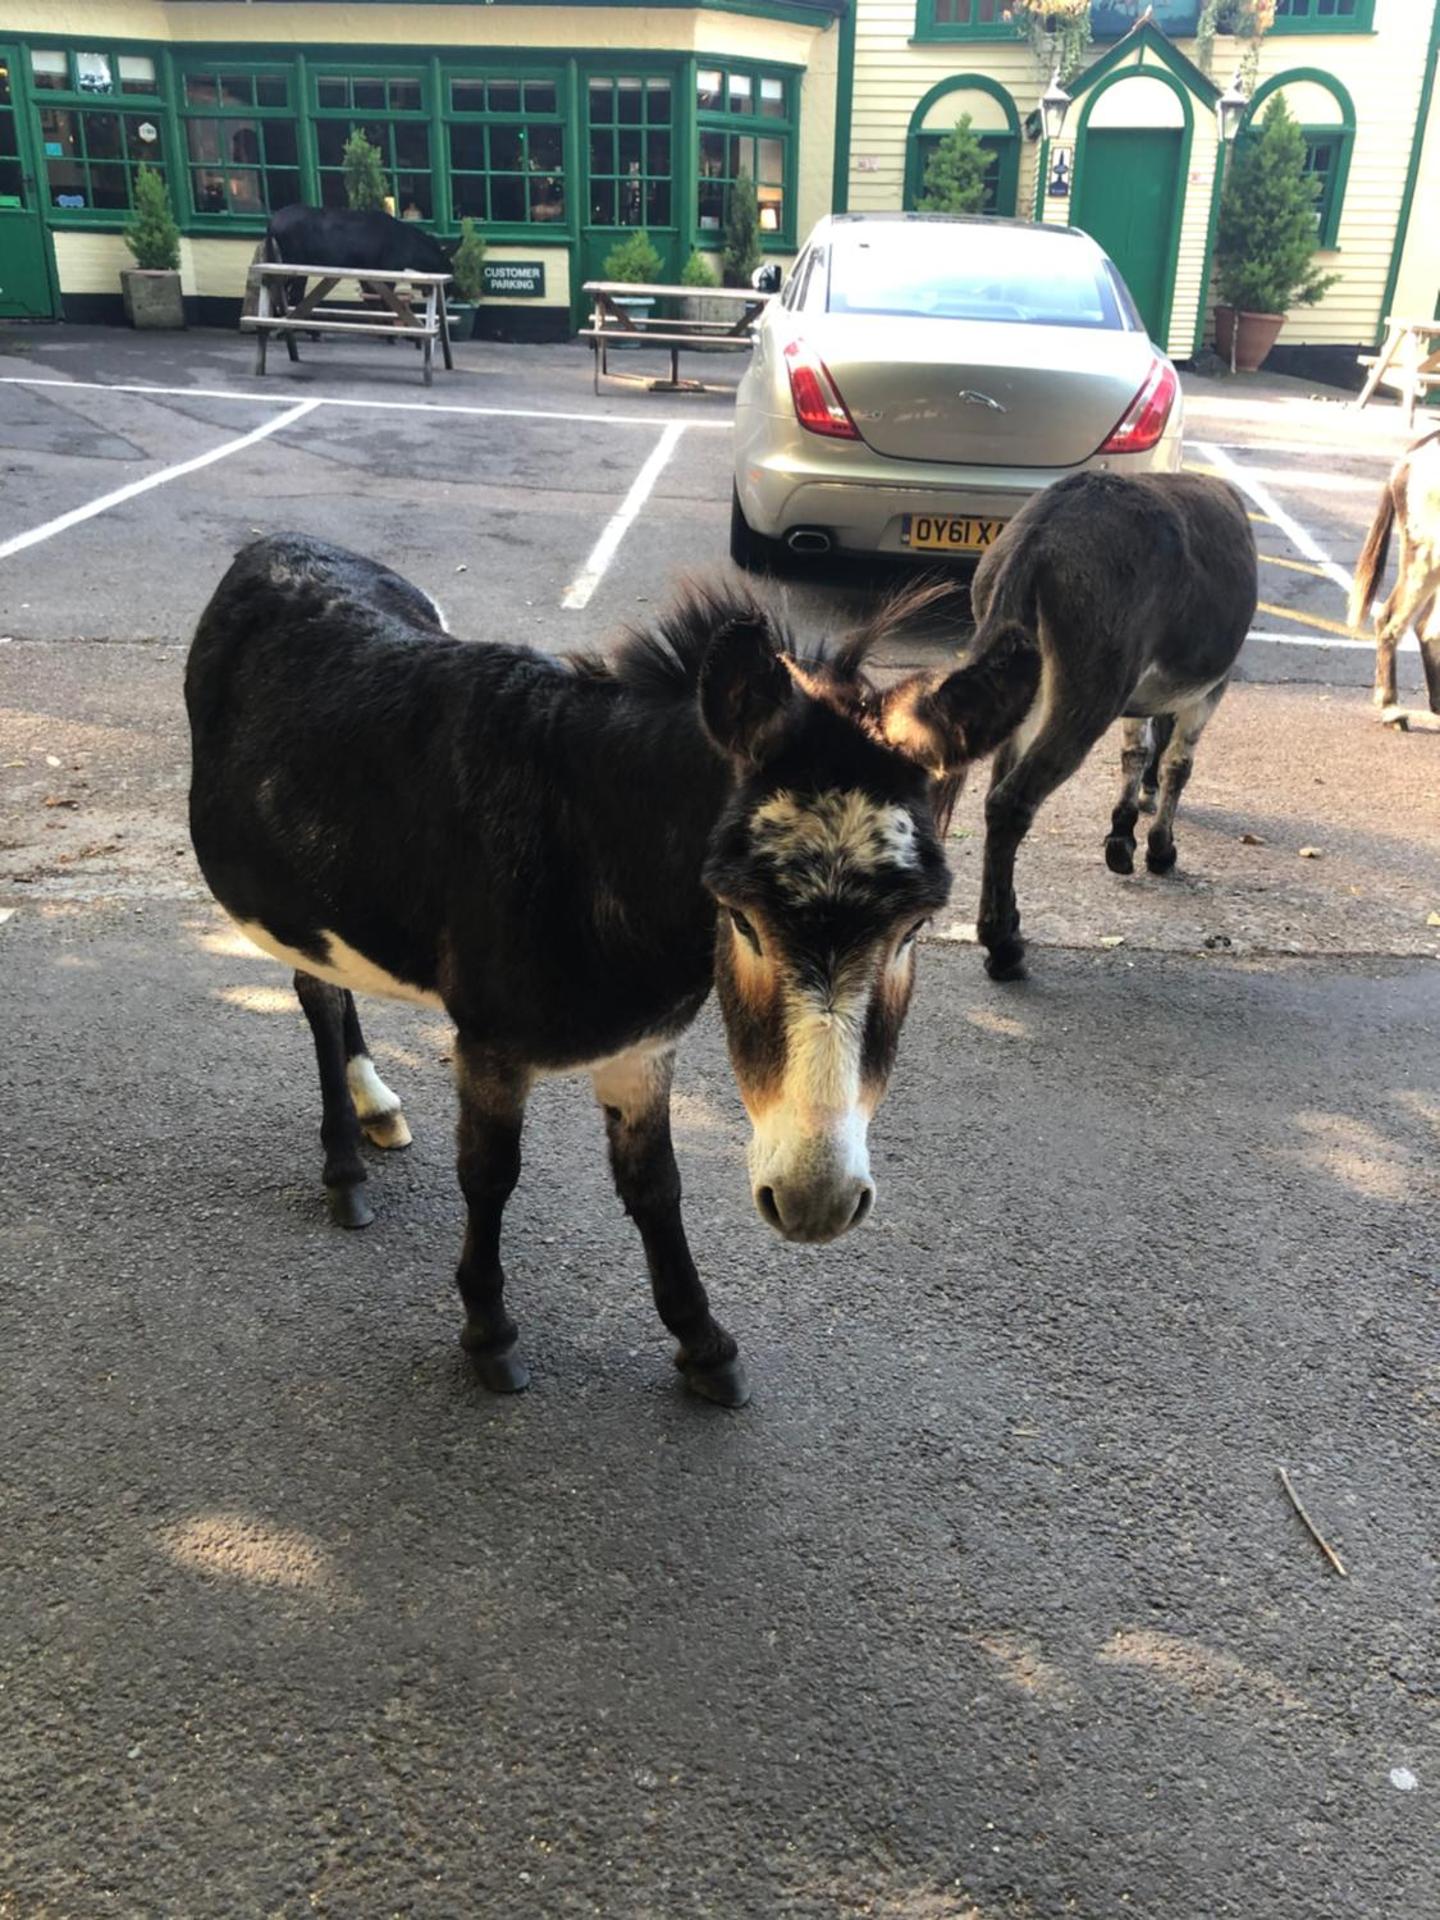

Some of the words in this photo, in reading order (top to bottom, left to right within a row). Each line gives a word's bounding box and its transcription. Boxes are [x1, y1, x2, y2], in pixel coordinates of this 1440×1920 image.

[484, 267, 540, 278] CUSTOMER
[490, 279, 534, 290] PARKING
[917, 518, 970, 544] OY61
